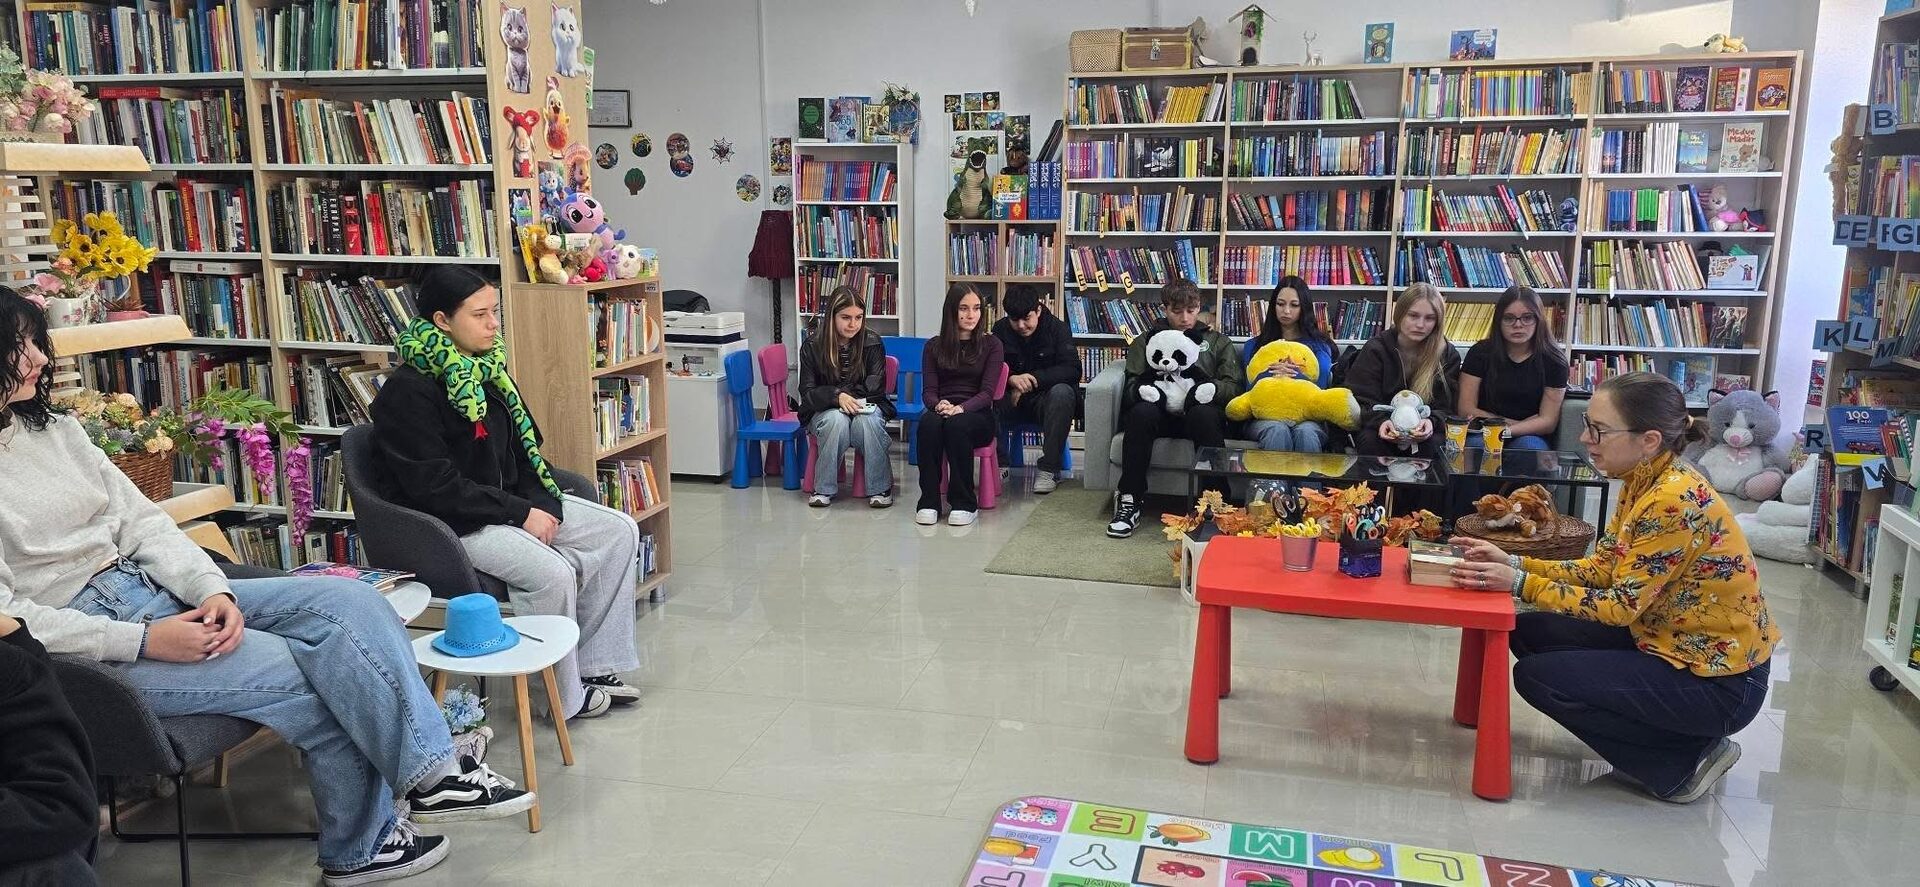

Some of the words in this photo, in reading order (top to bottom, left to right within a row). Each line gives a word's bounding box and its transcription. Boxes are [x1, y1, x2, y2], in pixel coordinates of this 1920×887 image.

[1874, 110, 1894, 128] B
[1852, 222, 1868, 242] E
[1892, 224, 1914, 244] G
[1078, 274, 1086, 287] E
[1097, 274, 1104, 287] F
[1124, 276, 1133, 288] G
[1824, 328, 1842, 347] K
[1853, 322, 1869, 342] L
[1875, 342, 1895, 358] M
[1845, 410, 1870, 420] 100
[1806, 430, 1823, 448] R
[1089, 809, 1136, 835] E
[1006, 830, 1051, 843] Food
[1245, 830, 1295, 859] M
[1069, 843, 1117, 871] Y
[1414, 853, 1464, 881] L
